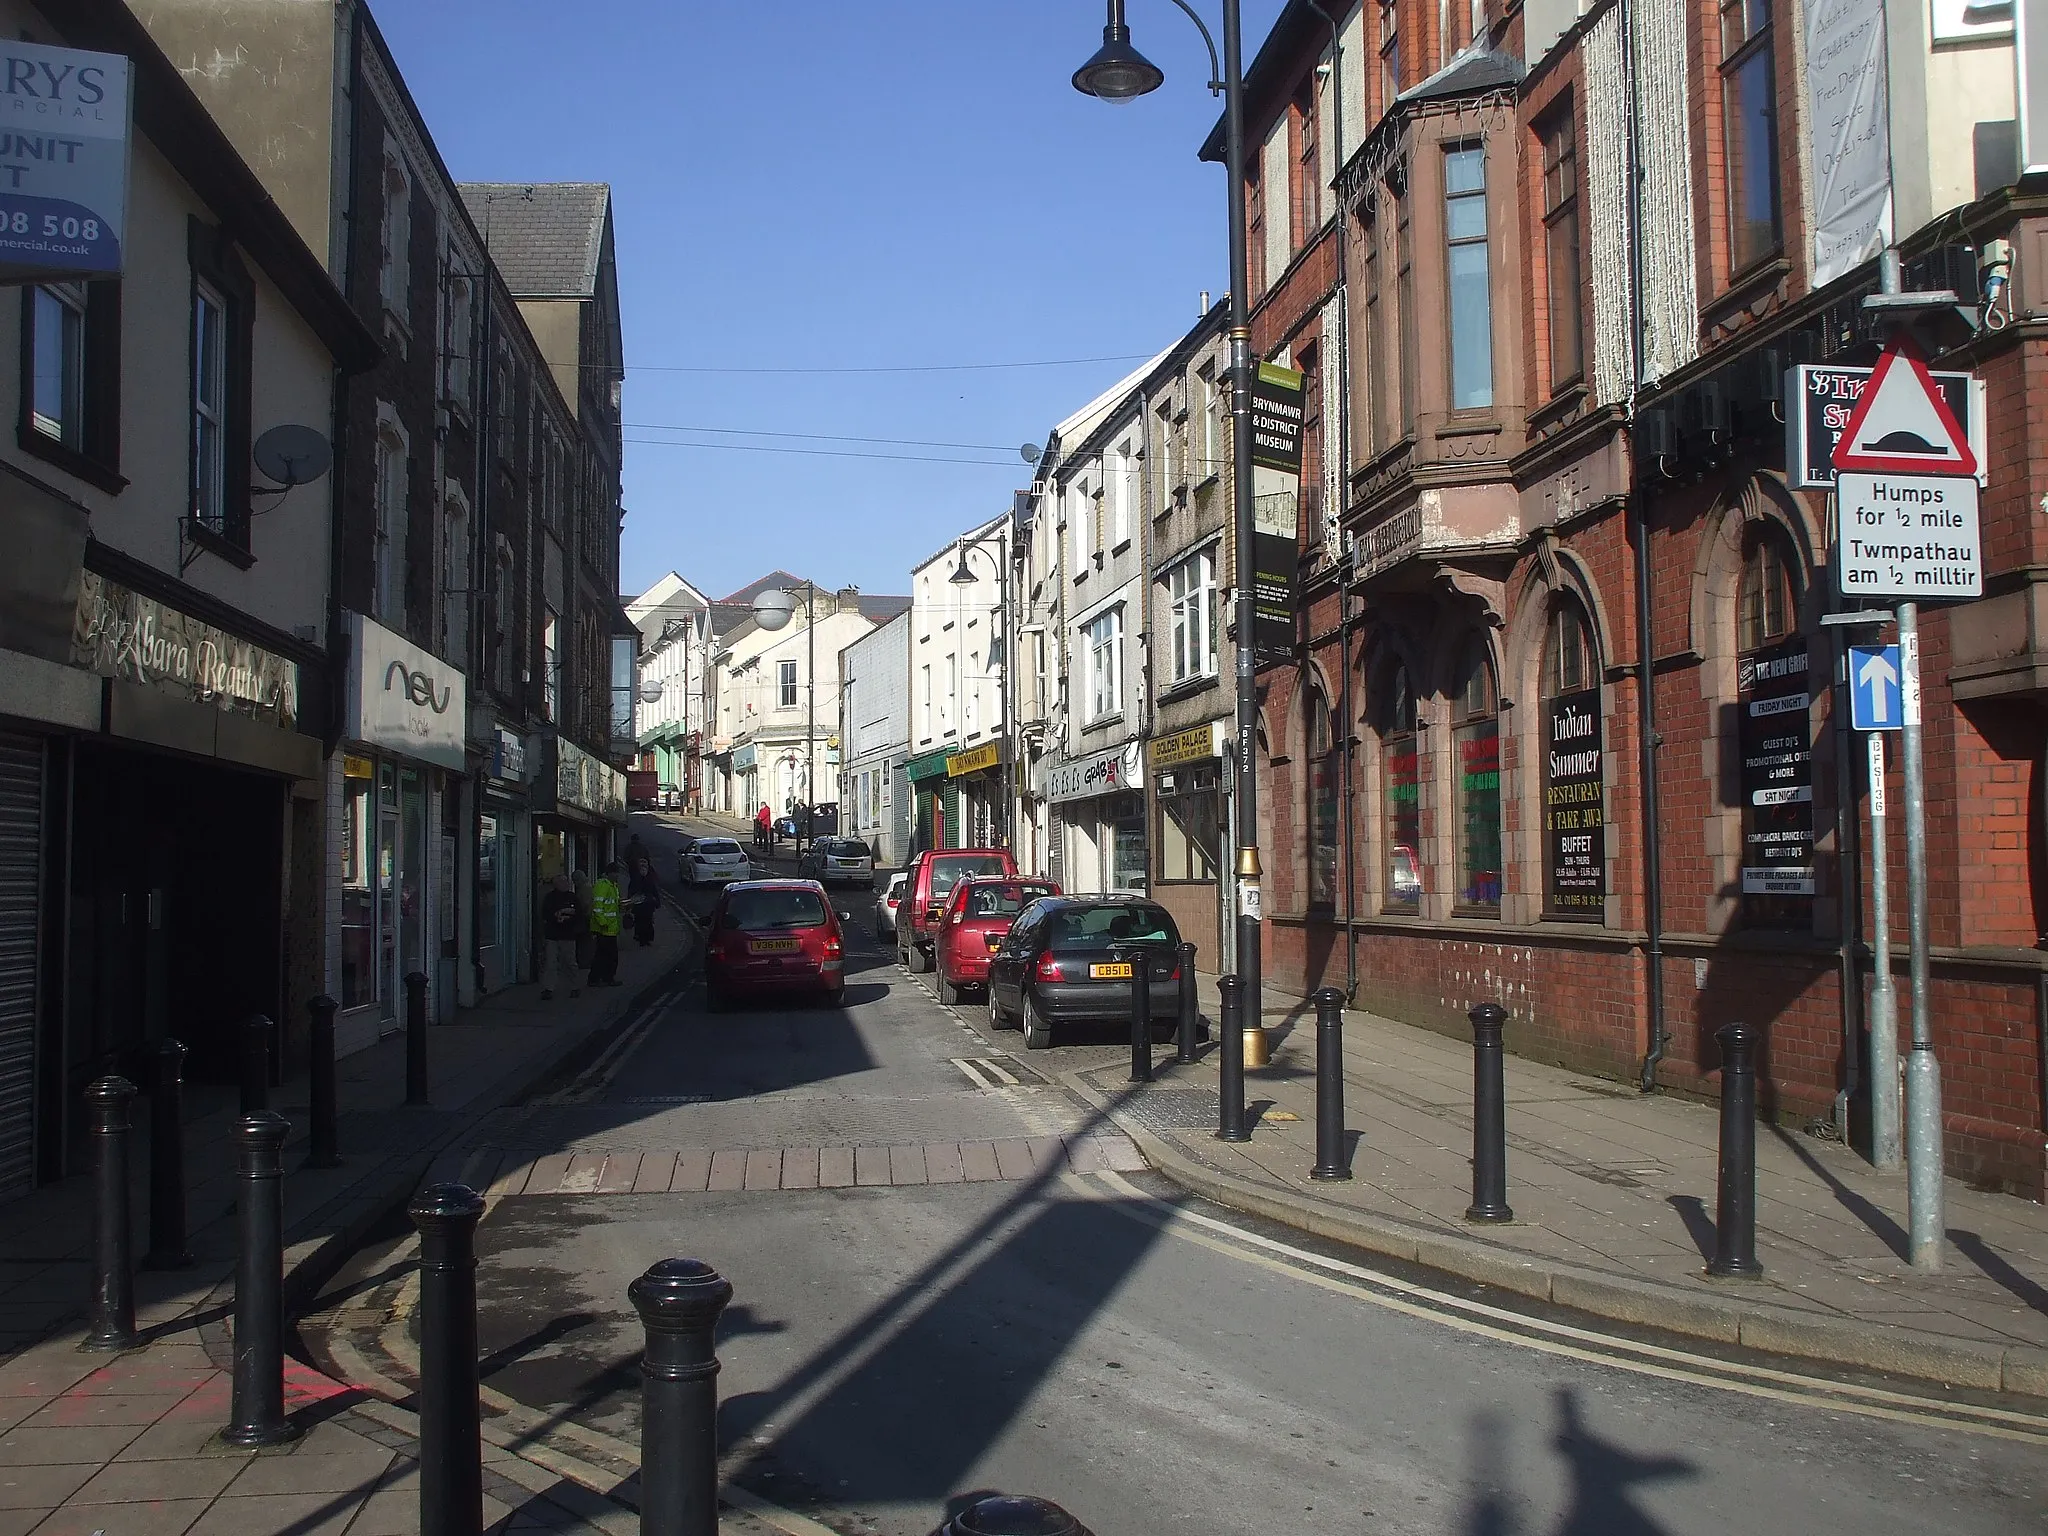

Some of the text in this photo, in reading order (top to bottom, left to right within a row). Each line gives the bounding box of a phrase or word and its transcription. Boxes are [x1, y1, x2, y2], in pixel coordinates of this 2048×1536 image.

[0, 57, 105, 105] RYS
[1817, 57, 1876, 111] Free Delivery
[0, 164, 30, 188] T
[42, 215, 100, 240] 508
[1252, 396, 1301, 420] BRYNMAWR
[1252, 414, 1299, 436] & DISTRICT
[1255, 432, 1293, 452] MUSEUM
[1873, 483, 1944, 505] Humps
[1856, 507, 1885, 525] for
[1921, 510, 1963, 527] mile
[1850, 539, 1971, 563] Twmpathau
[1848, 568, 1878, 584] am
[1915, 566, 1976, 586] milltir
[1755, 661, 1770, 681] THE
[1771, 657, 1787, 678] NEW
[1758, 697, 1802, 714] FRIDAY NIGHT
[1553, 704, 1593, 741] Indian
[1156, 736, 1180, 755] GOLDEN
[1181, 730, 1208, 750] PALACE
[1762, 736, 1799, 750] GUEST DJ'S
[1549, 750, 1599, 779] Summer
[1746, 751, 1812, 768] PROMOTIONAL OFFE
[1769, 768, 1795, 779] & MORE
[1547, 781, 1603, 805] RESTAURAN
[1764, 789, 1800, 802] SAT NIGHT
[1547, 808, 1604, 831] & TAKE AWA
[1562, 836, 1592, 853] BUFFET
[1782, 830, 1799, 841] DANCE
[756, 940, 793, 949] V36 NVH
[1098, 965, 1121, 976] CB51
